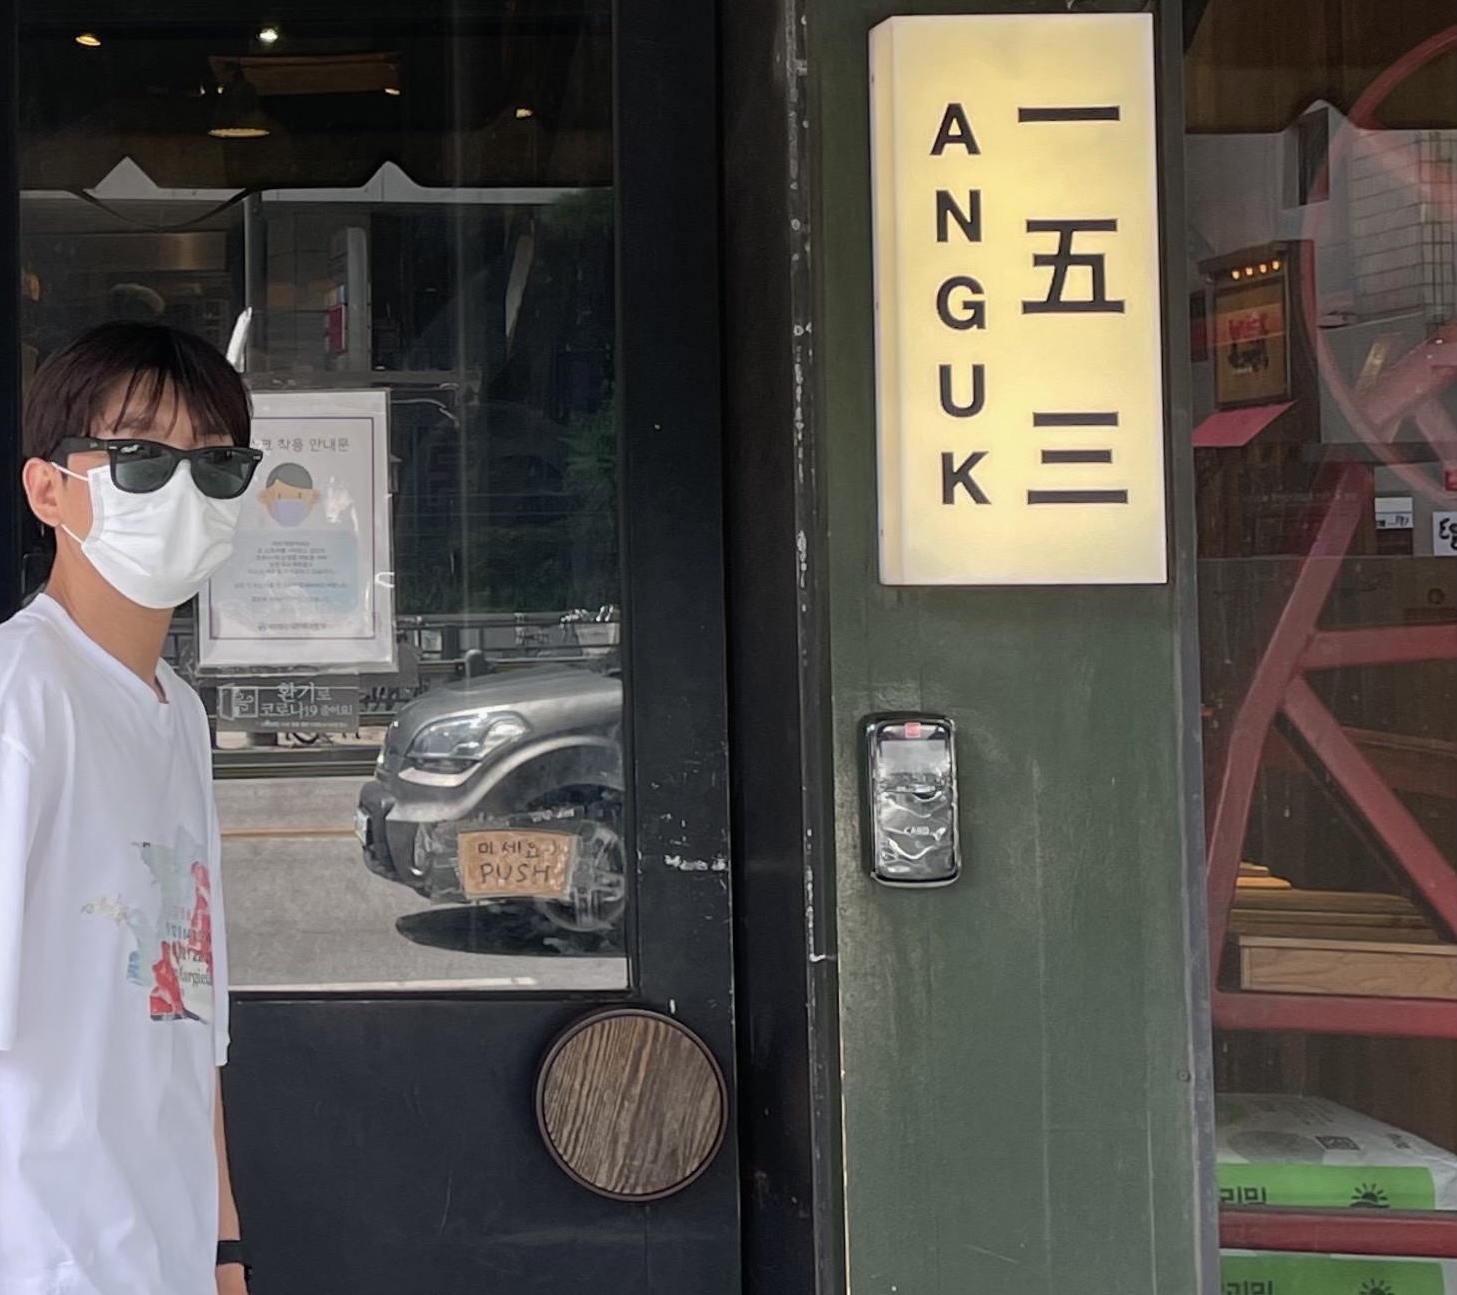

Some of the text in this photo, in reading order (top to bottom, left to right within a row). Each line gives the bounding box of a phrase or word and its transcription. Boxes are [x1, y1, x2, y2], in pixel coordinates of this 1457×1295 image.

[930, 102, 991, 505] ANGUK
[1018, 105, 1129, 504] 一五三
[278, 438, 304, 453] 착용
[309, 438, 351, 453] 안내문
[480, 862, 549, 885] PUSH
